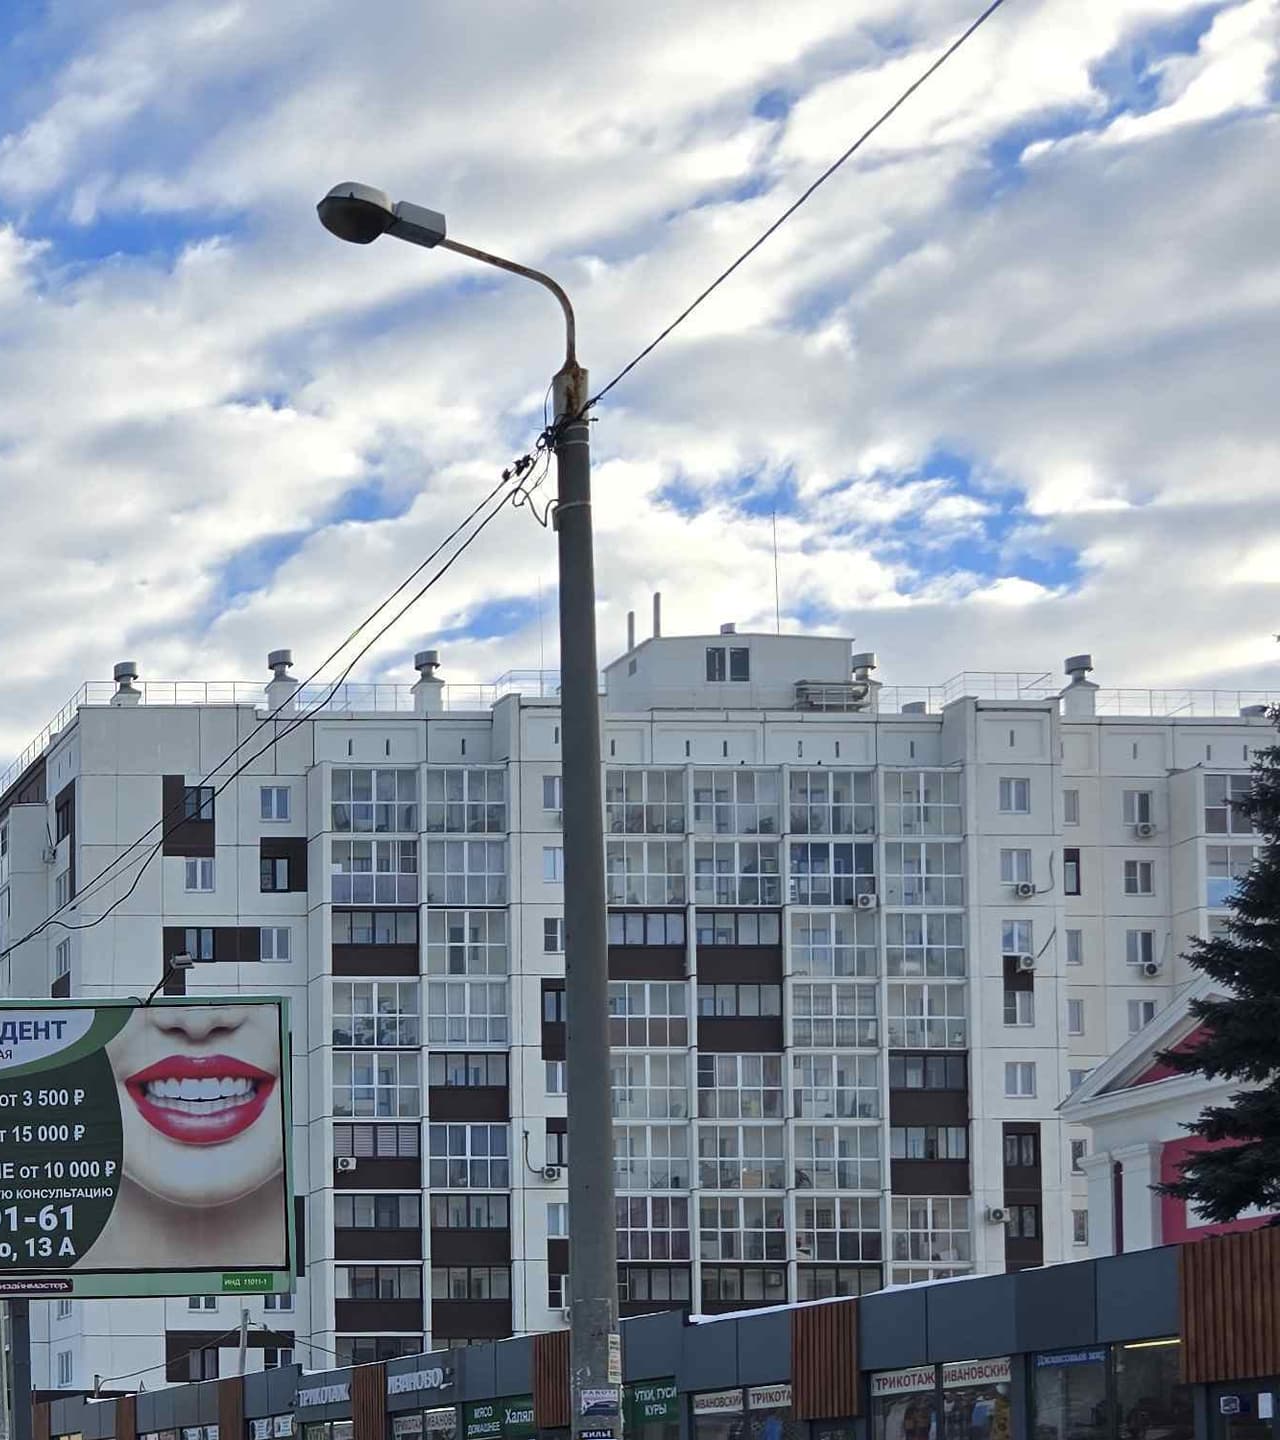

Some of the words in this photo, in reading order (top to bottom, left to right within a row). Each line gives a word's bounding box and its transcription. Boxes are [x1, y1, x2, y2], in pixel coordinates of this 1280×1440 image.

[22, 1090, 33, 1106] 3
[38, 1089, 69, 1106] 500
[12, 1126, 33, 1142] 15
[38, 1125, 69, 1142] 000
[19, 1166, 39, 1179] от
[44, 1161, 64, 1178] 10
[69, 1161, 100, 1178] 000
[16, 1187, 113, 1200] КОНСУЛЬТАЦИЮ
[25, 1237, 52, 1257] 13
[58, 1236, 76, 1256] А
[875, 1371, 936, 1391] ТРИКОТАЖ
[751, 1390, 791, 1405] ТРИКОТА
[505, 1409, 535, 1424] Халял
[645, 1403, 668, 1417] КУРЫ
